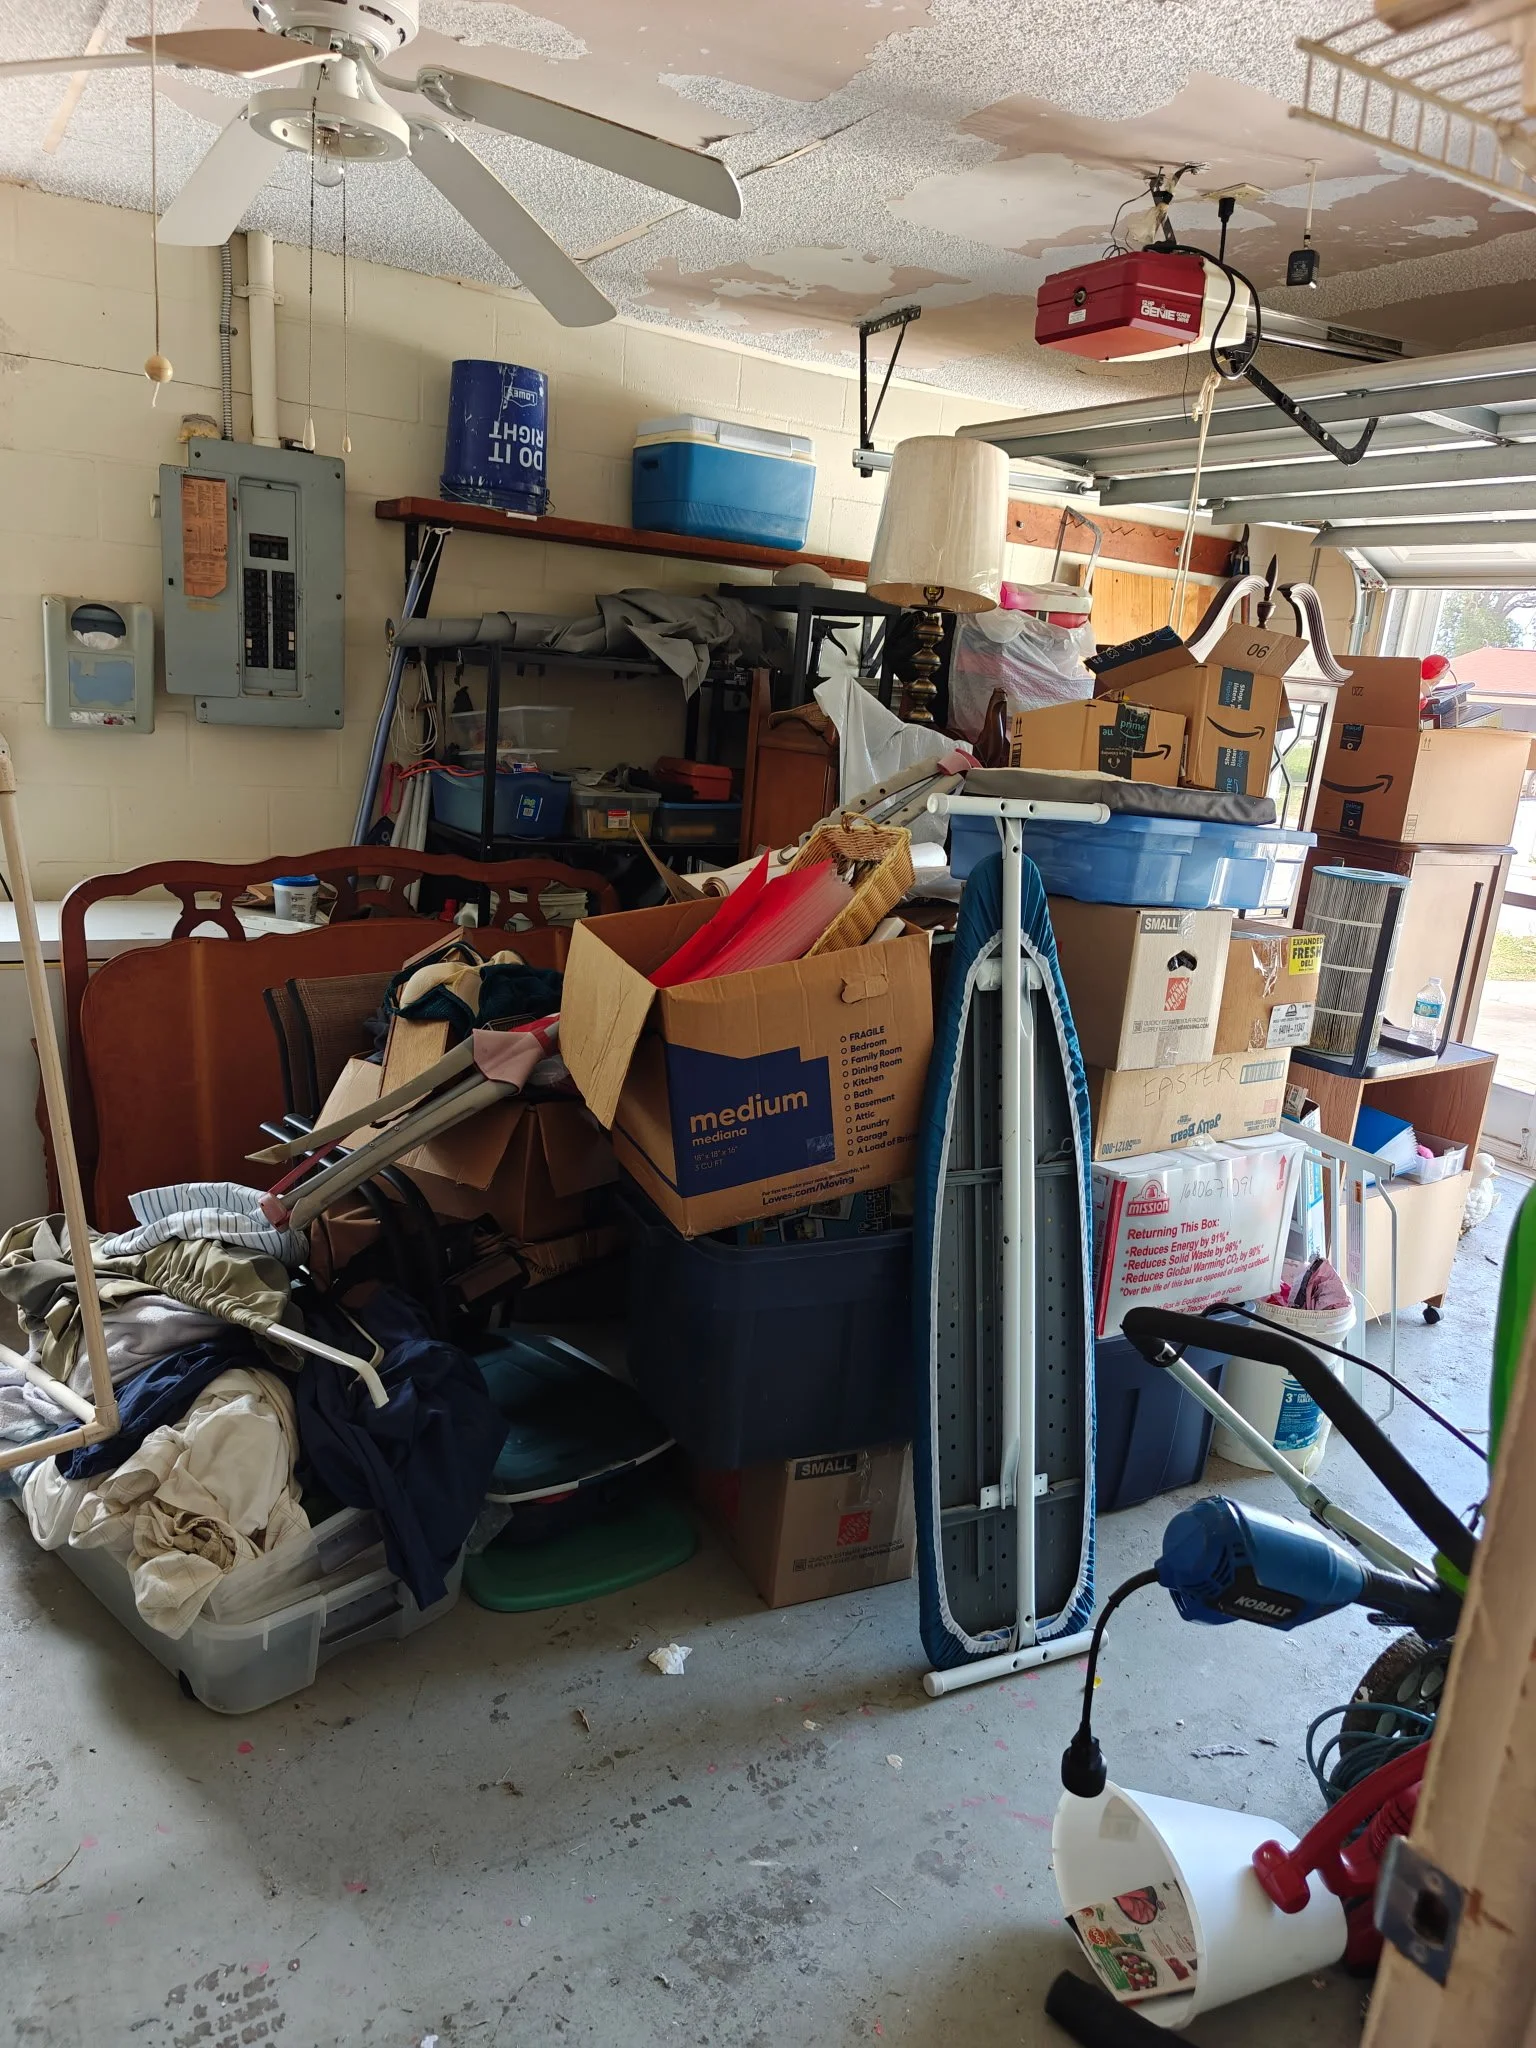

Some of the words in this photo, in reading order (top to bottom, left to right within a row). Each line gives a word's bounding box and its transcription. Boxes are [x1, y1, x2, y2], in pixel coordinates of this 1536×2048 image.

[1140, 306, 1176, 322] GENIE
[488, 420, 544, 448] RIGHT
[488, 442, 511, 464] IT
[519, 446, 543, 472] DO
[1120, 718, 1146, 732] prime
[1145, 917, 1178, 930] SMALL
[1293, 937, 1324, 946] EXPANDED
[1293, 946, 1322, 959] FRESH
[850, 1025, 885, 1041] FRAGILE
[850, 1039, 887, 1052] Bedroom
[851, 1052, 878, 1064] Family
[880, 1046, 902, 1057] Room
[852, 1064, 878, 1076] Dining
[880, 1058, 902, 1068] Room
[853, 1074, 884, 1087] Kitchen
[1144, 1056, 1235, 1107] EASTER
[854, 1088, 873, 1099] Bath
[854, 1094, 895, 1110] Basement
[690, 1090, 808, 1134] medium
[855, 1110, 875, 1122] Attic
[855, 1118, 890, 1132] Laundry
[1170, 1124, 1195, 1143] Bean
[1199, 1114, 1222, 1136] Jelly
[692, 1128, 747, 1146] mediana
[856, 1130, 888, 1143] Garage
[857, 1147, 863, 1155] A
[864, 1141, 886, 1152] Load
[887, 1138, 895, 1146] of
[700, 1162, 713, 1170] CU
[714, 1159, 723, 1167] FT
[762, 1176, 855, 1206] Lowes.com/Moving
[1276, 1181, 1284, 1190] UP
[1127, 1226, 1178, 1240] Returning
[1181, 1221, 1198, 1234] This
[1201, 1218, 1219, 1230] Box:
[1130, 1245, 1168, 1257] Reduces
[1171, 1240, 1199, 1252] Energy
[1200, 1236, 1209, 1248] by
[1125, 1272, 1164, 1284] Reduces
[1167, 1264, 1192, 1278] Global
[1193, 1258, 1225, 1272] Warming
[1240, 1250, 1247, 1260] by
[1128, 1258, 1166, 1270] Reduces
[1169, 1252, 1189, 1265] Solid
[1192, 1250, 1213, 1260] Waste
[1215, 1246, 1224, 1256] by
[1141, 1286, 1151, 1294] the
[1153, 1284, 1162, 1292] life
[1163, 1281, 1170, 1290] of
[1172, 1280, 1182, 1288] this
[1184, 1277, 1194, 1285] box
[1204, 1269, 1227, 1281] opposed
[1227, 1267, 1233, 1275] of
[1234, 1264, 1247, 1273] using
[1181, 1293, 1210, 1305] Equipped
[1226, 1285, 1242, 1294] Radio
[801, 1458, 852, 1476] SMALL
[1234, 1596, 1292, 1617] KOBALT
